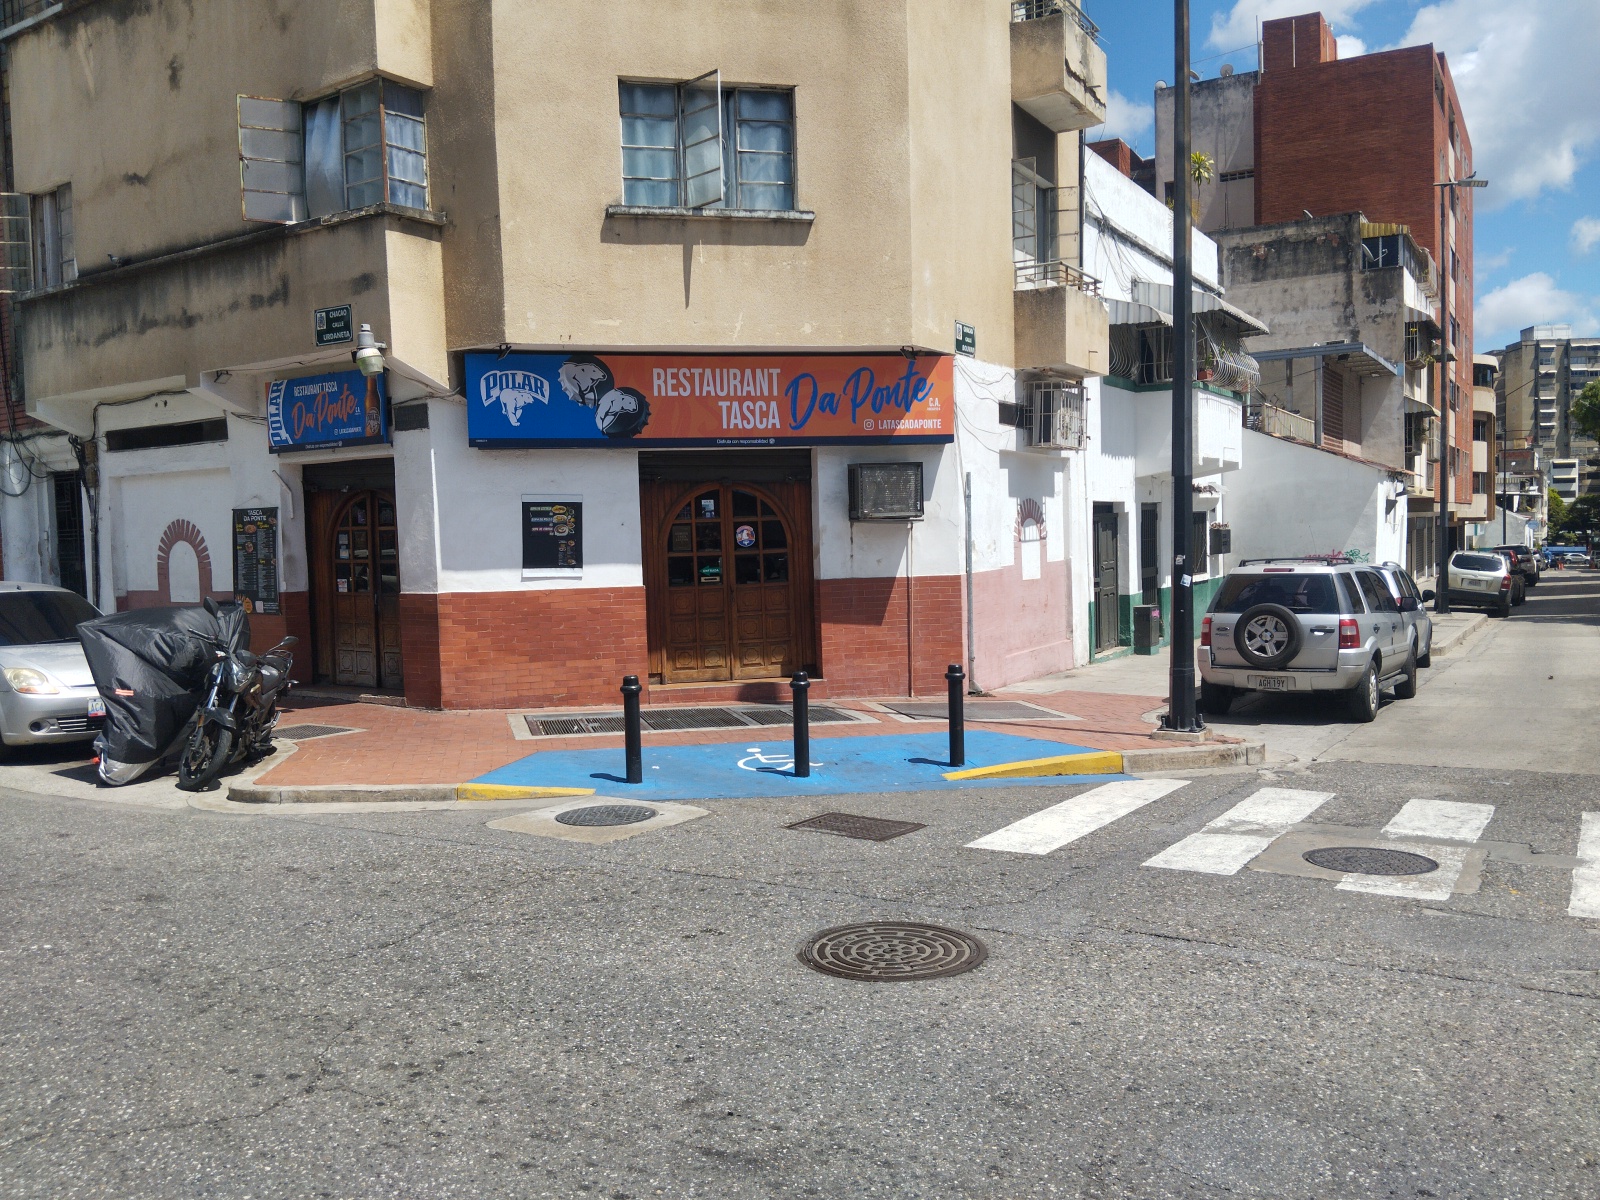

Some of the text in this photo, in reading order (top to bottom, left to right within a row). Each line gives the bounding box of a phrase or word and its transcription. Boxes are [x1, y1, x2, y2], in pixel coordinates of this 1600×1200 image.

[329, 309, 347, 318] CHACAO
[332, 320, 344, 328] CALLE
[323, 330, 350, 341] URDANETA
[293, 381, 338, 397] RESTAURANT TASCA
[482, 371, 547, 400] POLAR
[653, 367, 781, 397] RESTAURANT
[784, 359, 934, 431] Da Ponte
[928, 397, 941, 407] C.A.
[269, 382, 289, 446] POLAR
[291, 383, 358, 440] Da Ponte
[718, 401, 781, 429] TASCA
[878, 419, 942, 429] LATASCADAPONTE
[1258, 679, 1285, 688] AGH 19Y
